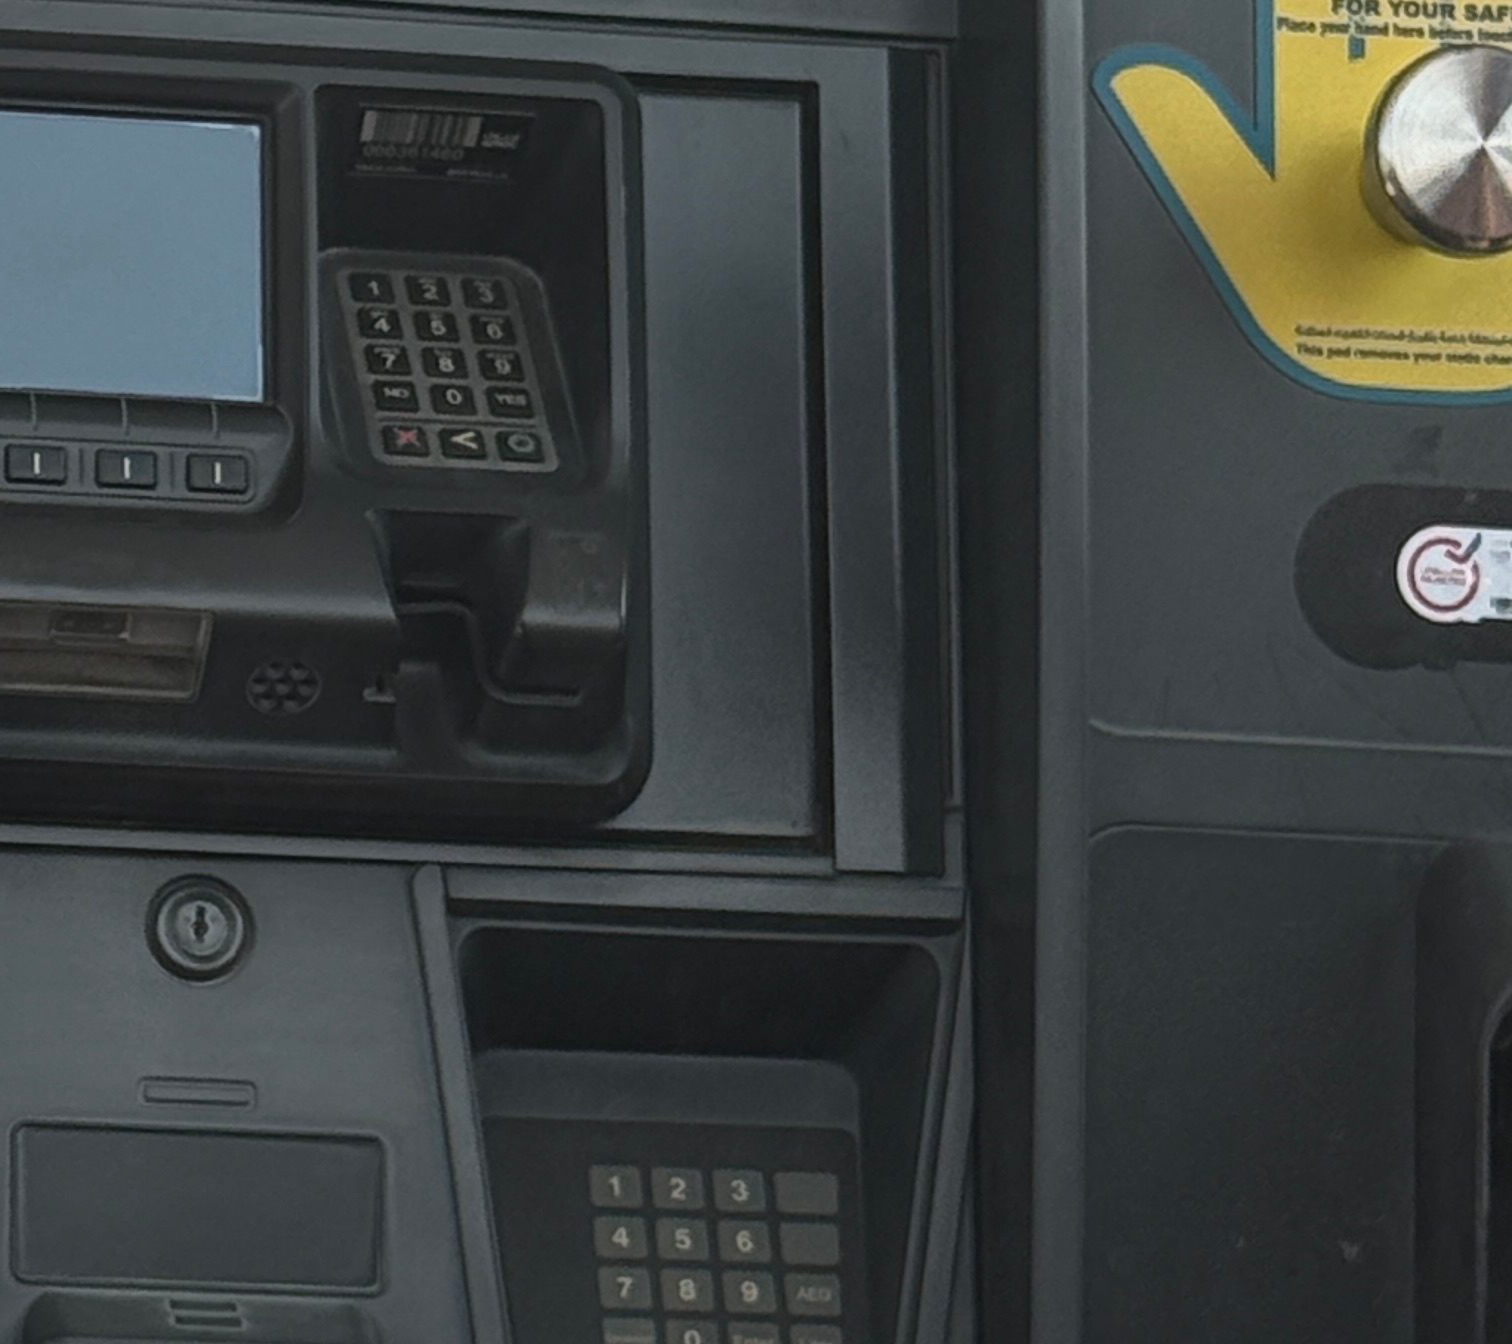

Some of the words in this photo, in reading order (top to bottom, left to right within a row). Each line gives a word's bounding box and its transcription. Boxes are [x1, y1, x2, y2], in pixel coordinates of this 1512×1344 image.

[1388, 0, 1456, 20] YOUR
[1464, 4, 1512, 22] SAF
[367, 280, 379, 297] 1
[422, 285, 439, 301] 2
[477, 287, 494, 303] 3
[373, 317, 391, 334] 4
[430, 319, 447, 336] 5
[486, 323, 503, 340] 6
[381, 352, 396, 369] 7
[438, 356, 455, 373] 8
[494, 359, 511, 375] 9
[445, 388, 463, 405] 0
[494, 393, 527, 406] YES
[608, 1176, 621, 1197] 1
[669, 1178, 687, 1201] 2
[730, 1180, 750, 1202] 3
[611, 1227, 631, 1248] 4
[674, 1229, 691, 1250] 5
[735, 1230, 754, 1253] 6
[616, 1276, 633, 1299] 7
[678, 1279, 697, 1301] 8
[740, 1281, 759, 1303] 9
[796, 1286, 832, 1301] AED
